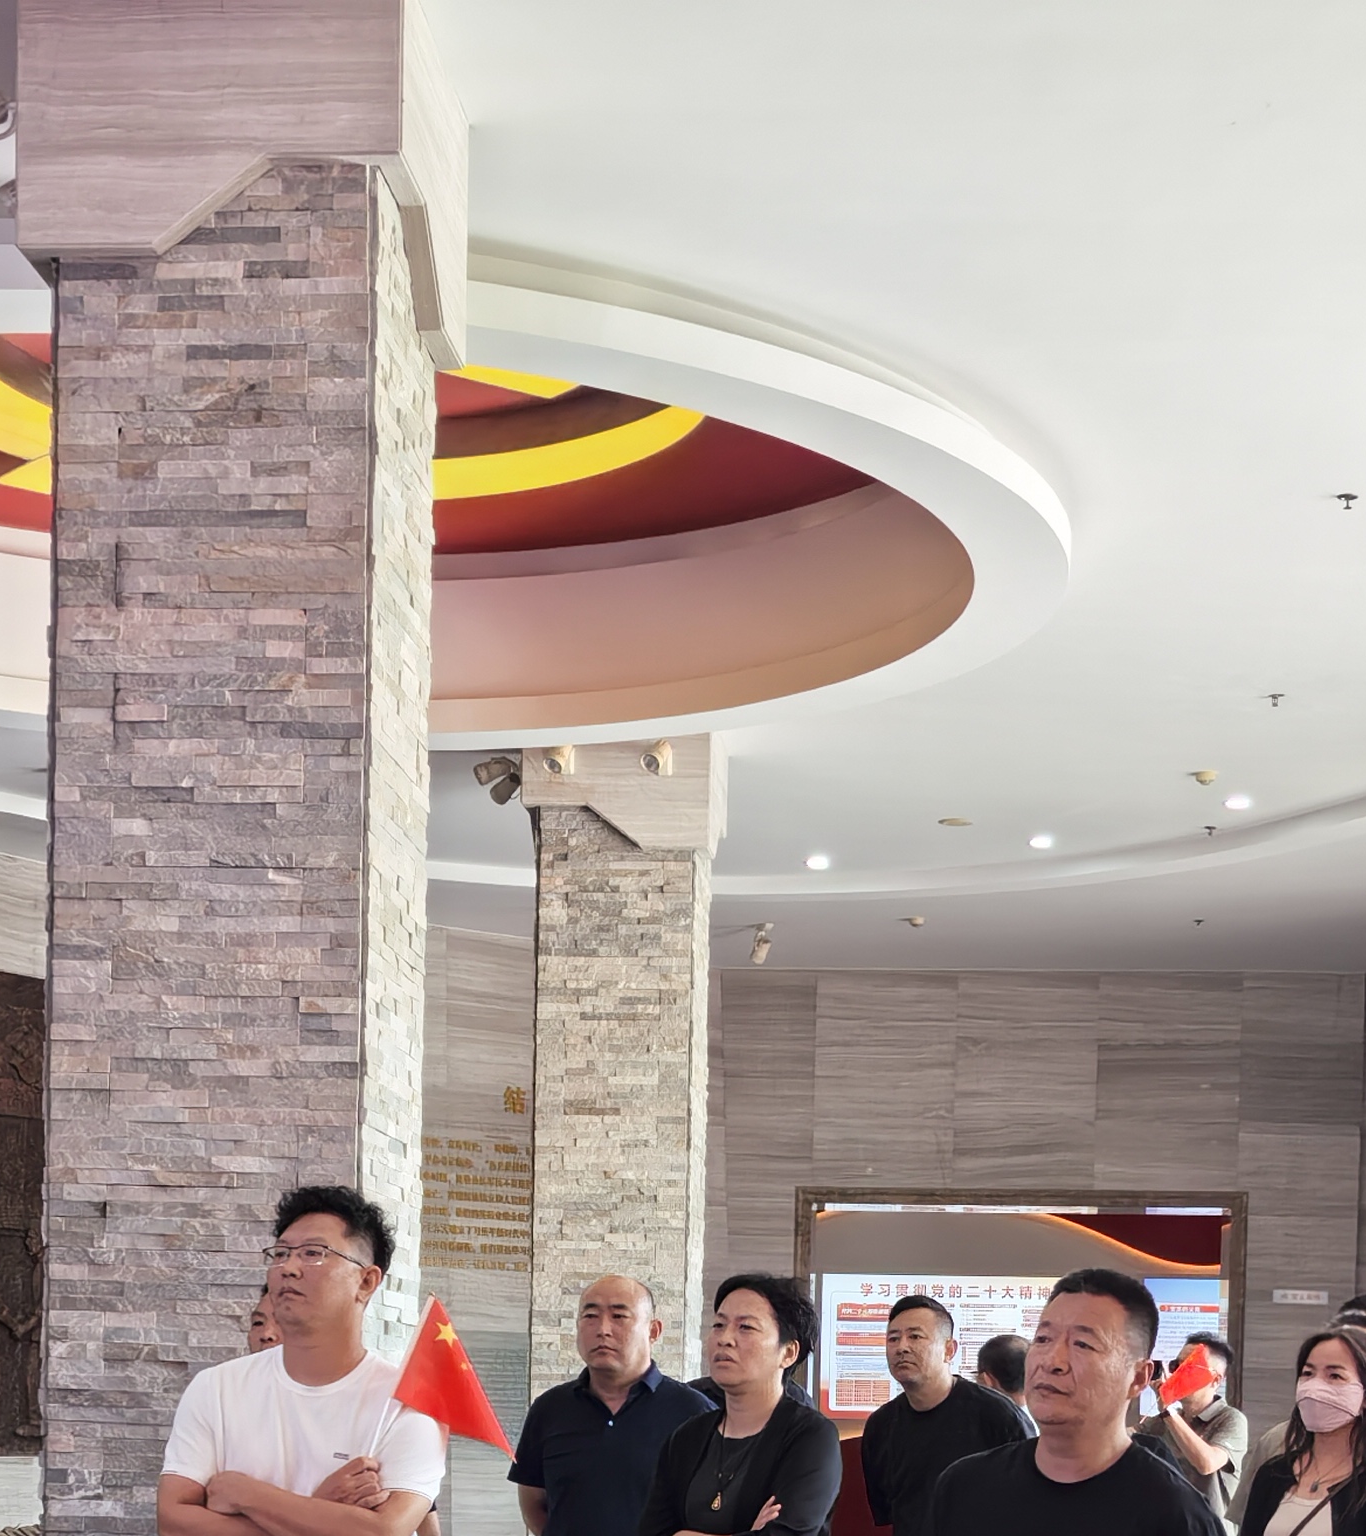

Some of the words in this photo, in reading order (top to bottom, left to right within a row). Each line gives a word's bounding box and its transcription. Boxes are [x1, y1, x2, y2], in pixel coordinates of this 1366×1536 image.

[860, 1282, 1052, 1300] 学习贯彻党的二十大精神
